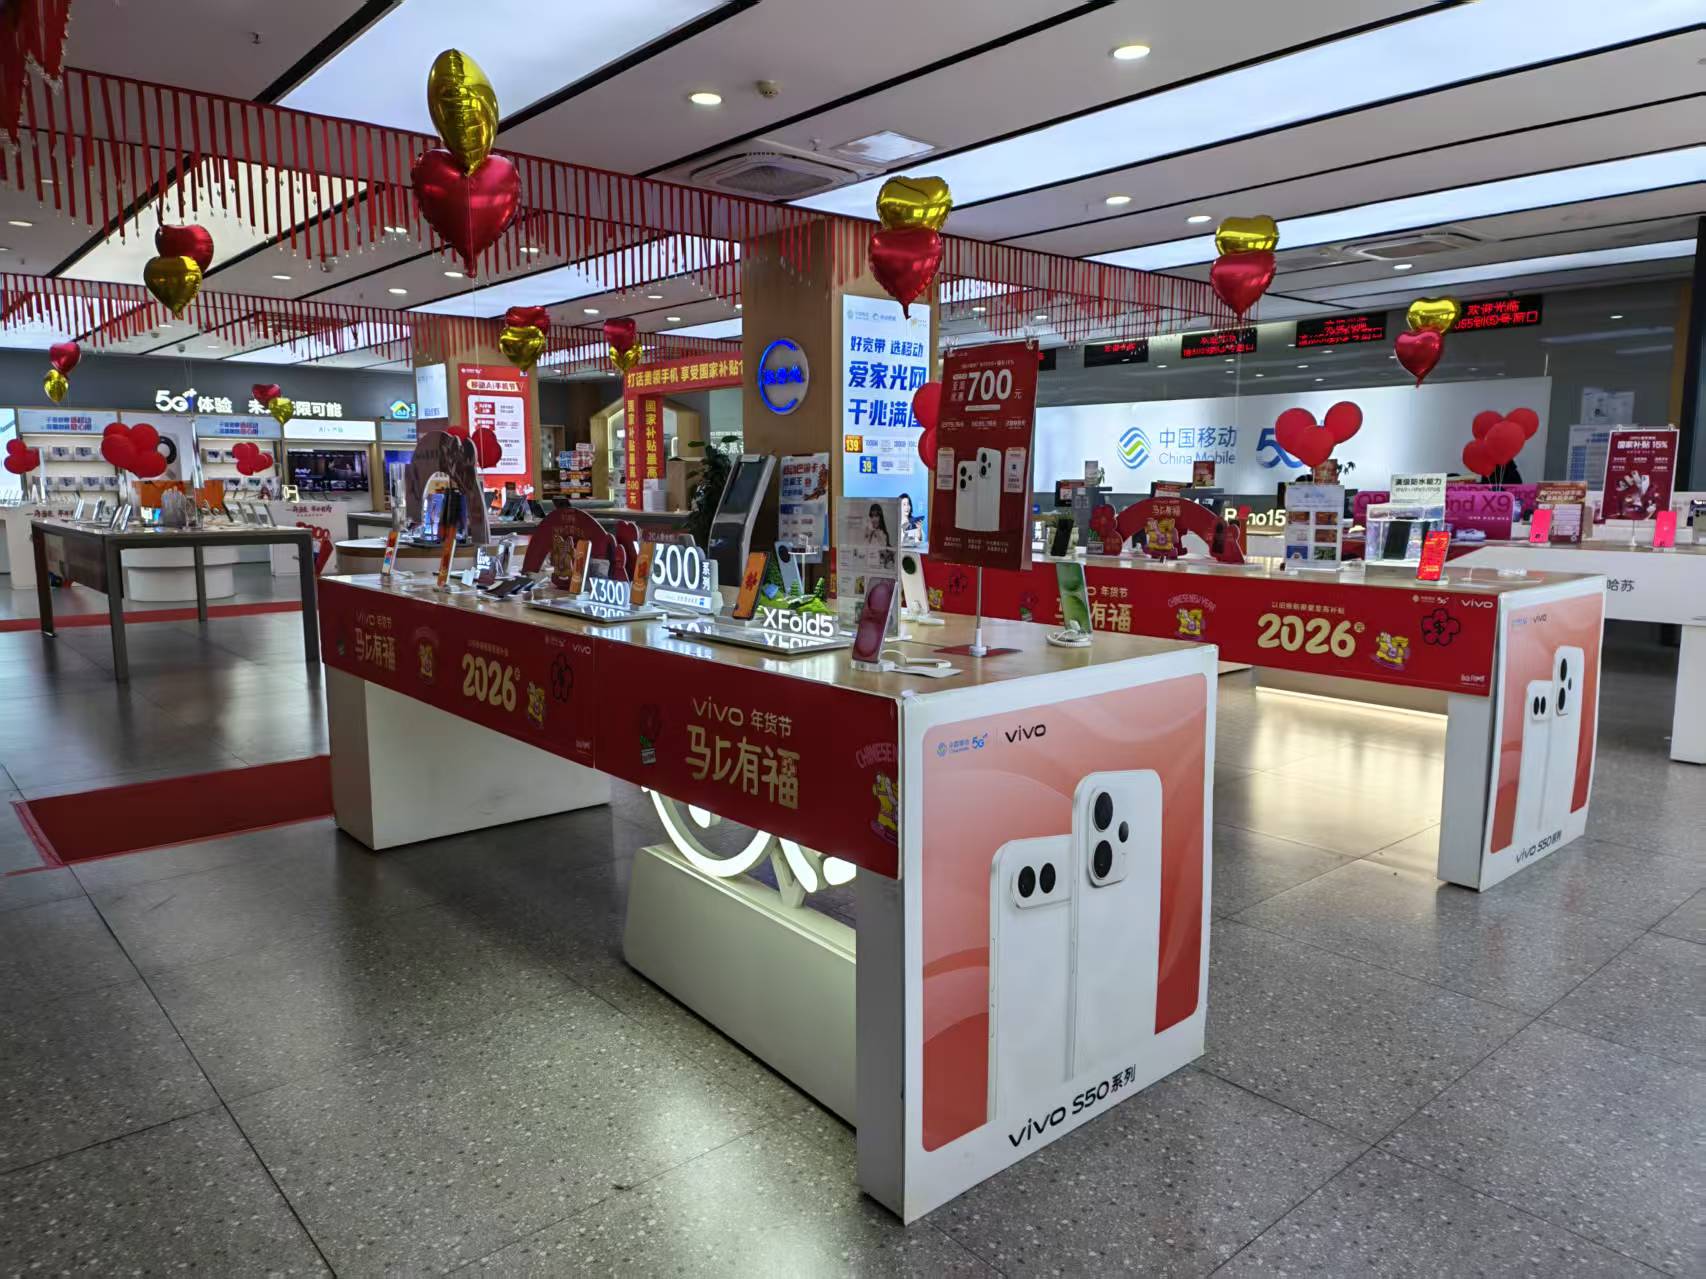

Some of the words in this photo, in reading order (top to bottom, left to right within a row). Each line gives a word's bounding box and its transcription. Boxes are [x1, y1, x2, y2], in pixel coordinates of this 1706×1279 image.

[850, 335, 886, 354] 好宽带
[890, 340, 924, 357] 选移动
[848, 360, 928, 392] 爱家光网
[967, 369, 1012, 402] 700
[1014, 386, 1025, 400] 元
[197, 397, 233, 414] 体验
[248, 399, 343, 418] 未限可能
[846, 438, 860, 452] 139
[1159, 425, 1238, 448] 中国移动
[862, 461, 872, 474] 39
[1158, 451, 1193, 465] China
[1195, 450, 1237, 465] Mobile
[1482, 494, 1511, 514] X9
[1224, 507, 1287, 527] Rno15
[588, 577, 625, 606] X300
[1101, 586, 1129, 598] 年货节
[1607, 578, 1635, 592] 哈苏
[1461, 598, 1494, 609] vivo
[763, 607, 834, 638] XFold5
[1257, 613, 1356, 658] 2026
[572, 643, 592, 655] vivo
[462, 653, 517, 713] 2026
[692, 696, 744, 727] vivo
[750, 708, 793, 738] 年货节
[1004, 723, 1047, 744] vivo
[1515, 844, 1537, 864] vivo
[1008, 1105, 1067, 1149] vivo
[1071, 1063, 1137, 1118] S50系列
